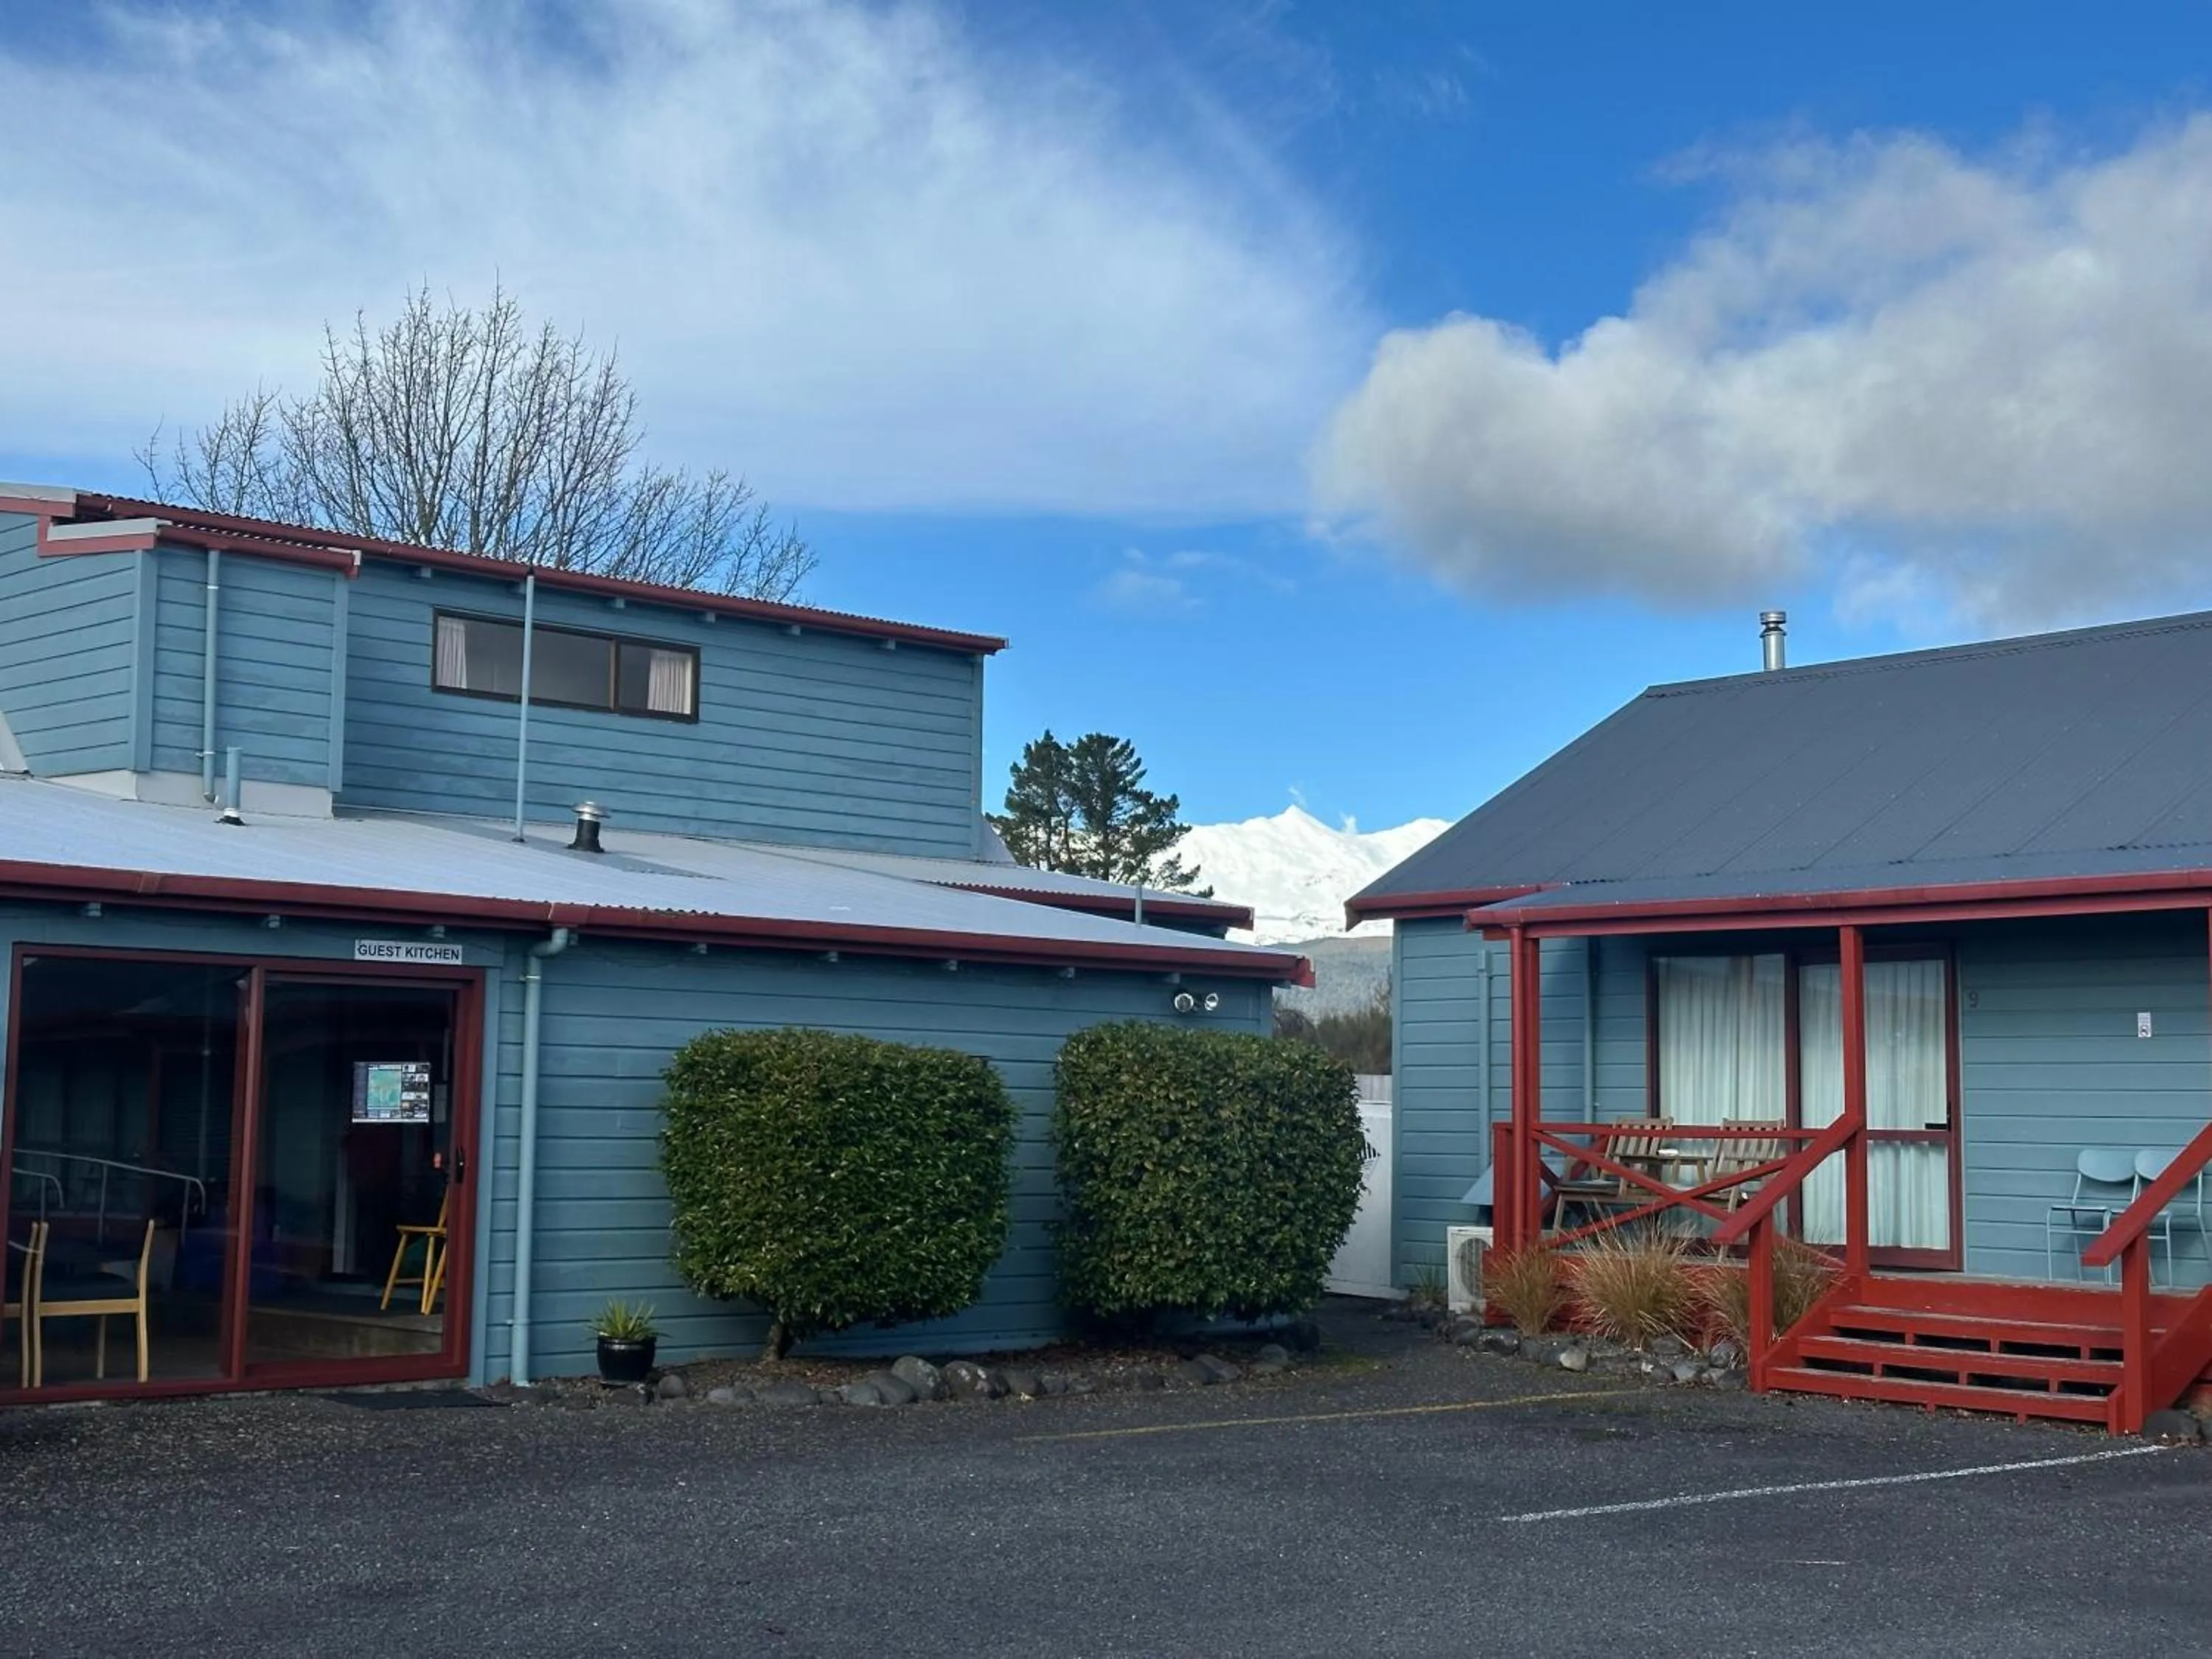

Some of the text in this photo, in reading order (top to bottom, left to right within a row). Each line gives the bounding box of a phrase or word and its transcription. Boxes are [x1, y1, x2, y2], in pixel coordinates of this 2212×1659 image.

[358, 945, 459, 960] GUEST KITCHEN
[1969, 990, 1979, 1008] 9
